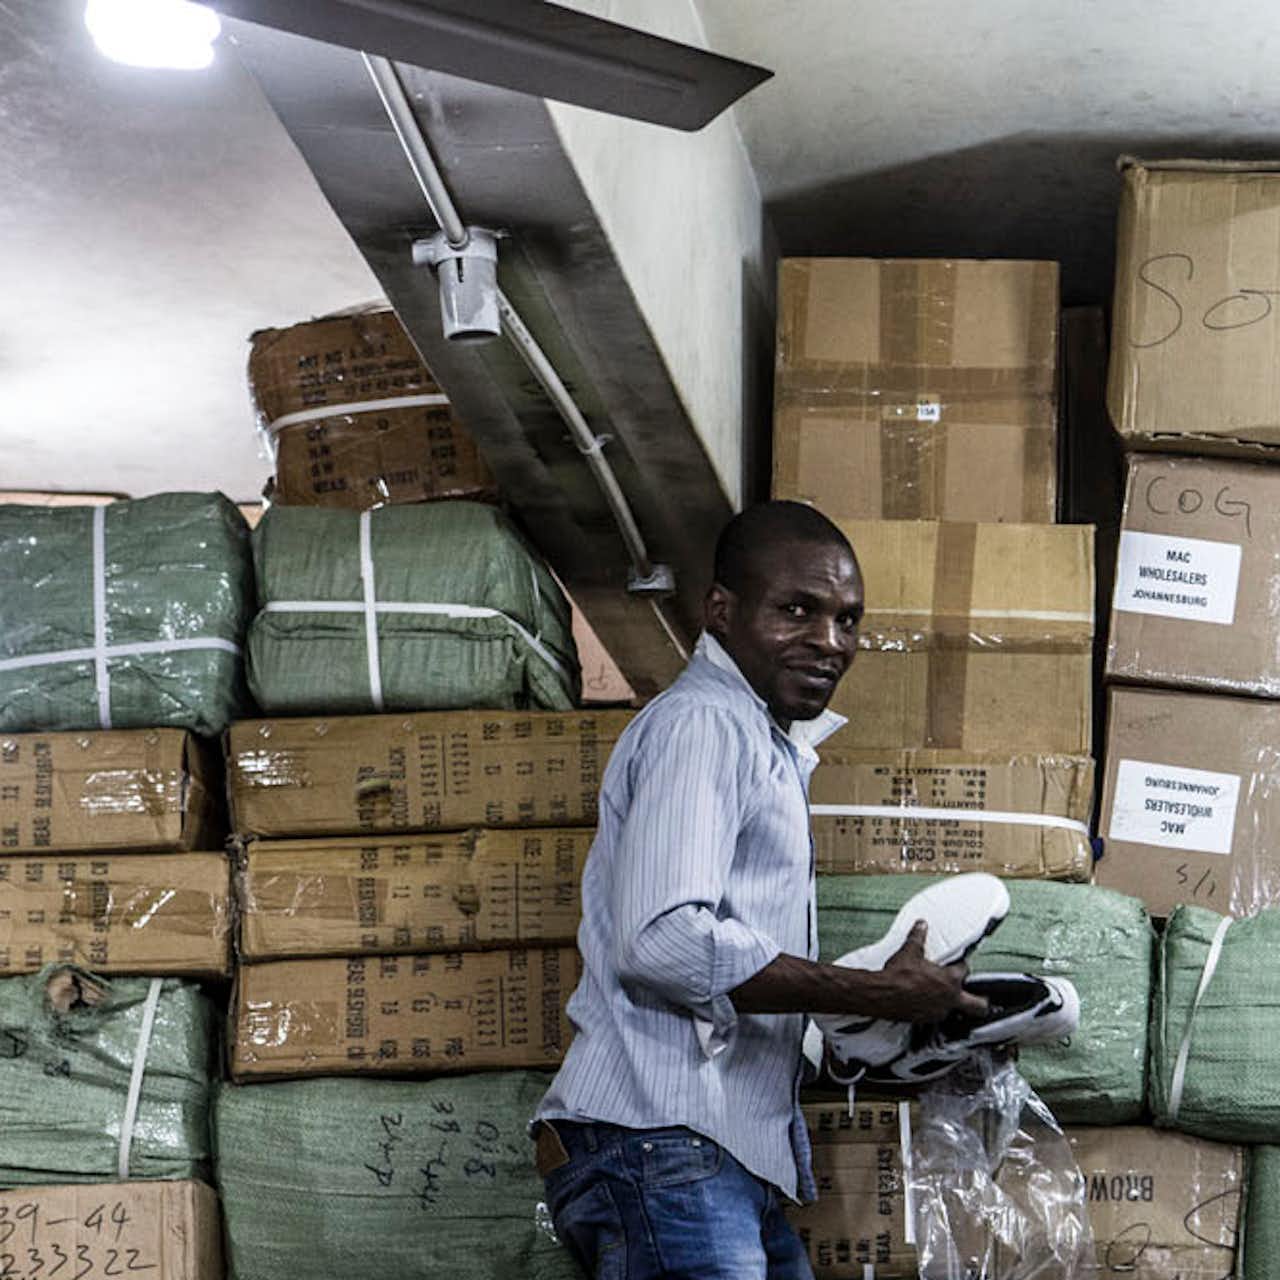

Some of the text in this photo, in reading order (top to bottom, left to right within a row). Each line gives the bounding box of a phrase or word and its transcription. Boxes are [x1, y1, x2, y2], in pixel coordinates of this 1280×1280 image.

[1166, 550, 1191, 564] MAC
[1139, 564, 1208, 587] WHOLESALERS
[1132, 588, 1208, 608] JOHANNESBURG
[1145, 776, 1220, 796] JOHANNESBURG
[1145, 798, 1213, 818] WHOLESALERS
[1160, 820, 1186, 835] MAC
[1078, 1174, 1154, 1202] BROW
